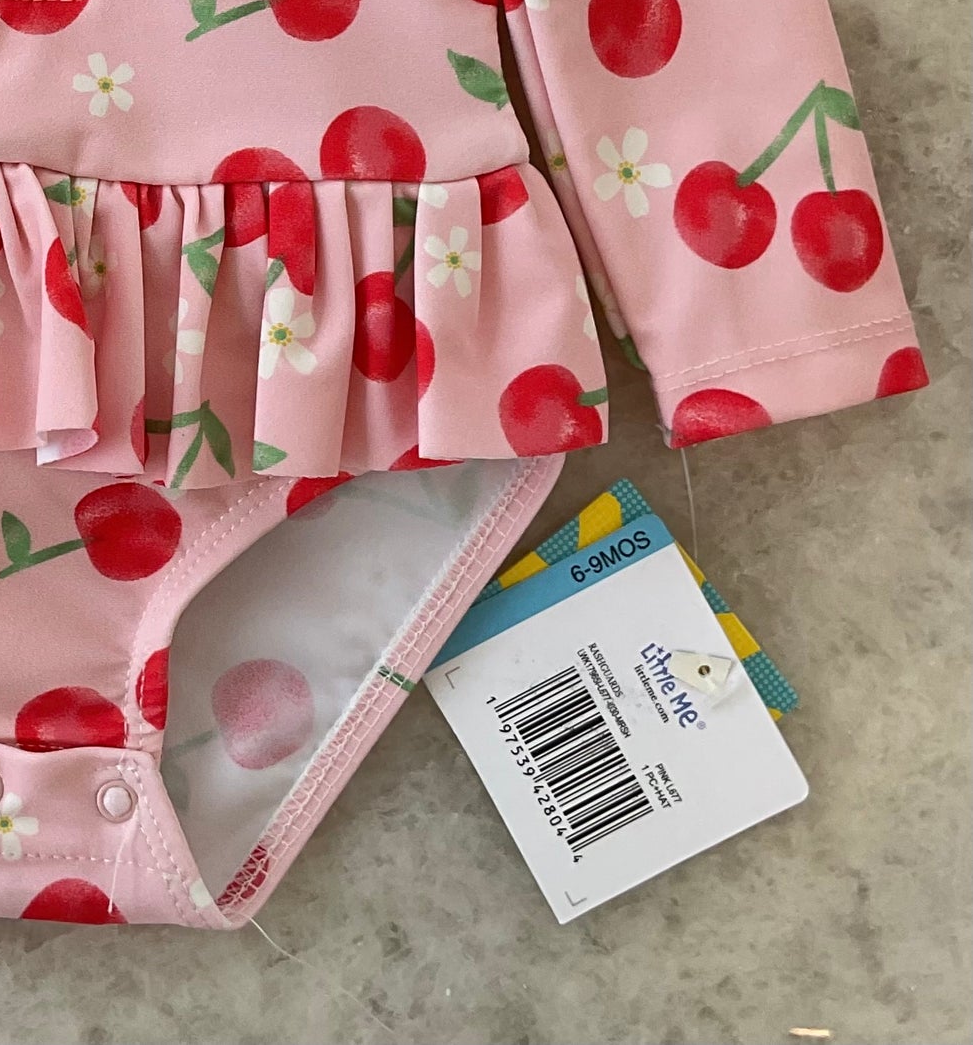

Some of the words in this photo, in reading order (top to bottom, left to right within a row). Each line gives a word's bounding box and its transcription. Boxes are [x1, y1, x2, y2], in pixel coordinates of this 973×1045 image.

[570, 530, 651, 583] 6-9MOS
[588, 642, 624, 698] RASHGUARDS
[634, 664, 670, 724] littleme.com
[486, 696, 497, 705] 1
[498, 723, 536, 777] 97539
[533, 784, 568, 837] 42804
[573, 855, 583, 863] 4
[655, 763, 672, 786] PINK
[665, 782, 683, 803] L677
